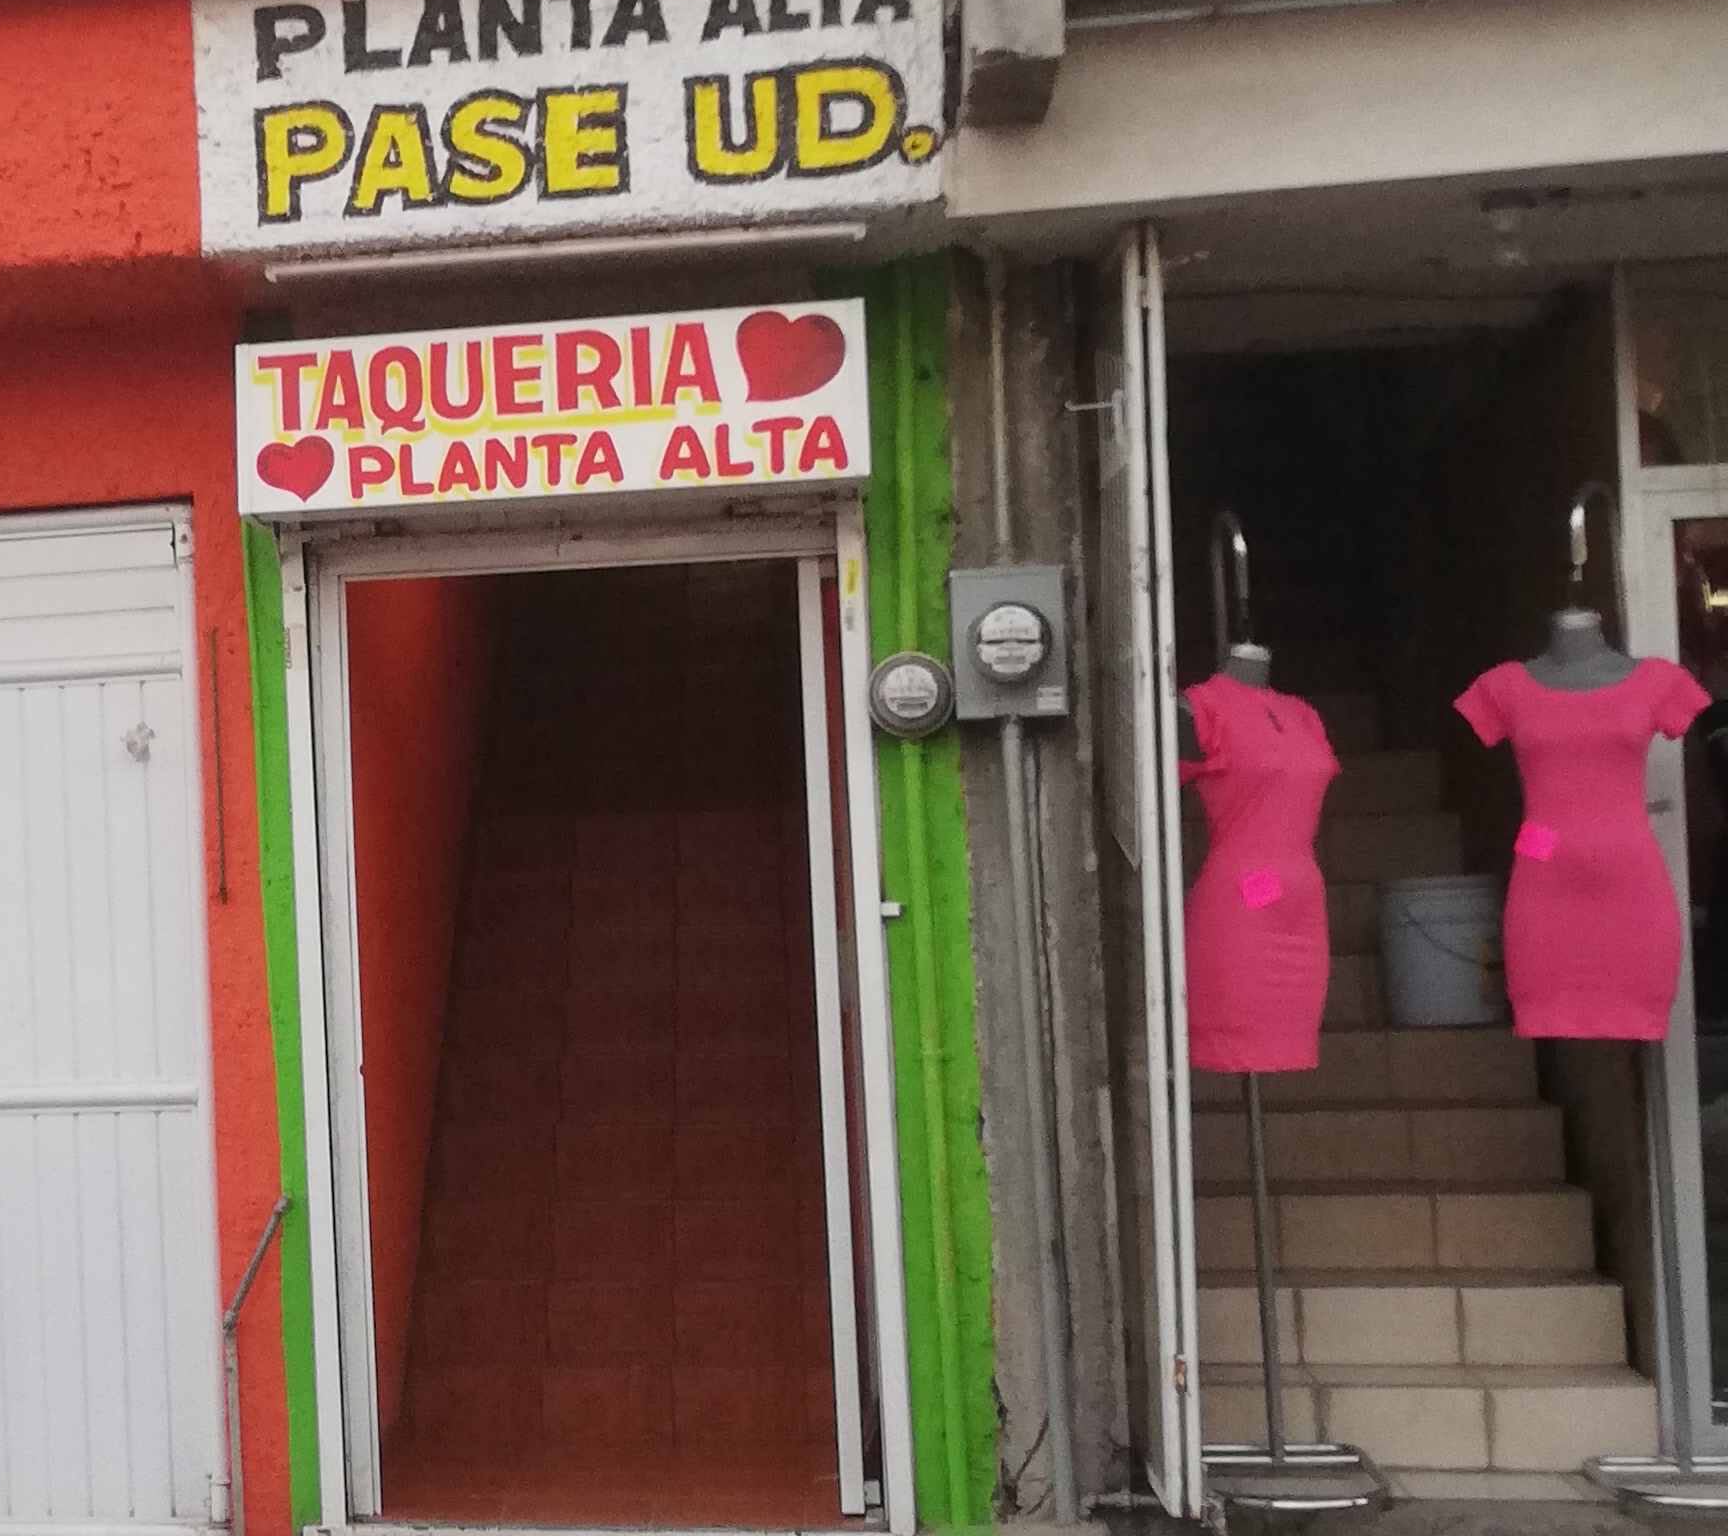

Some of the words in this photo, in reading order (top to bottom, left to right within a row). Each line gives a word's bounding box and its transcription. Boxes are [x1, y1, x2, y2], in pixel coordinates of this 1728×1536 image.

[256, 82, 630, 227] PASE
[682, 56, 939, 184] UD.
[256, 321, 722, 435] TAQUERIA
[346, 432, 625, 501] PLANTA
[658, 414, 849, 482] ALTA
